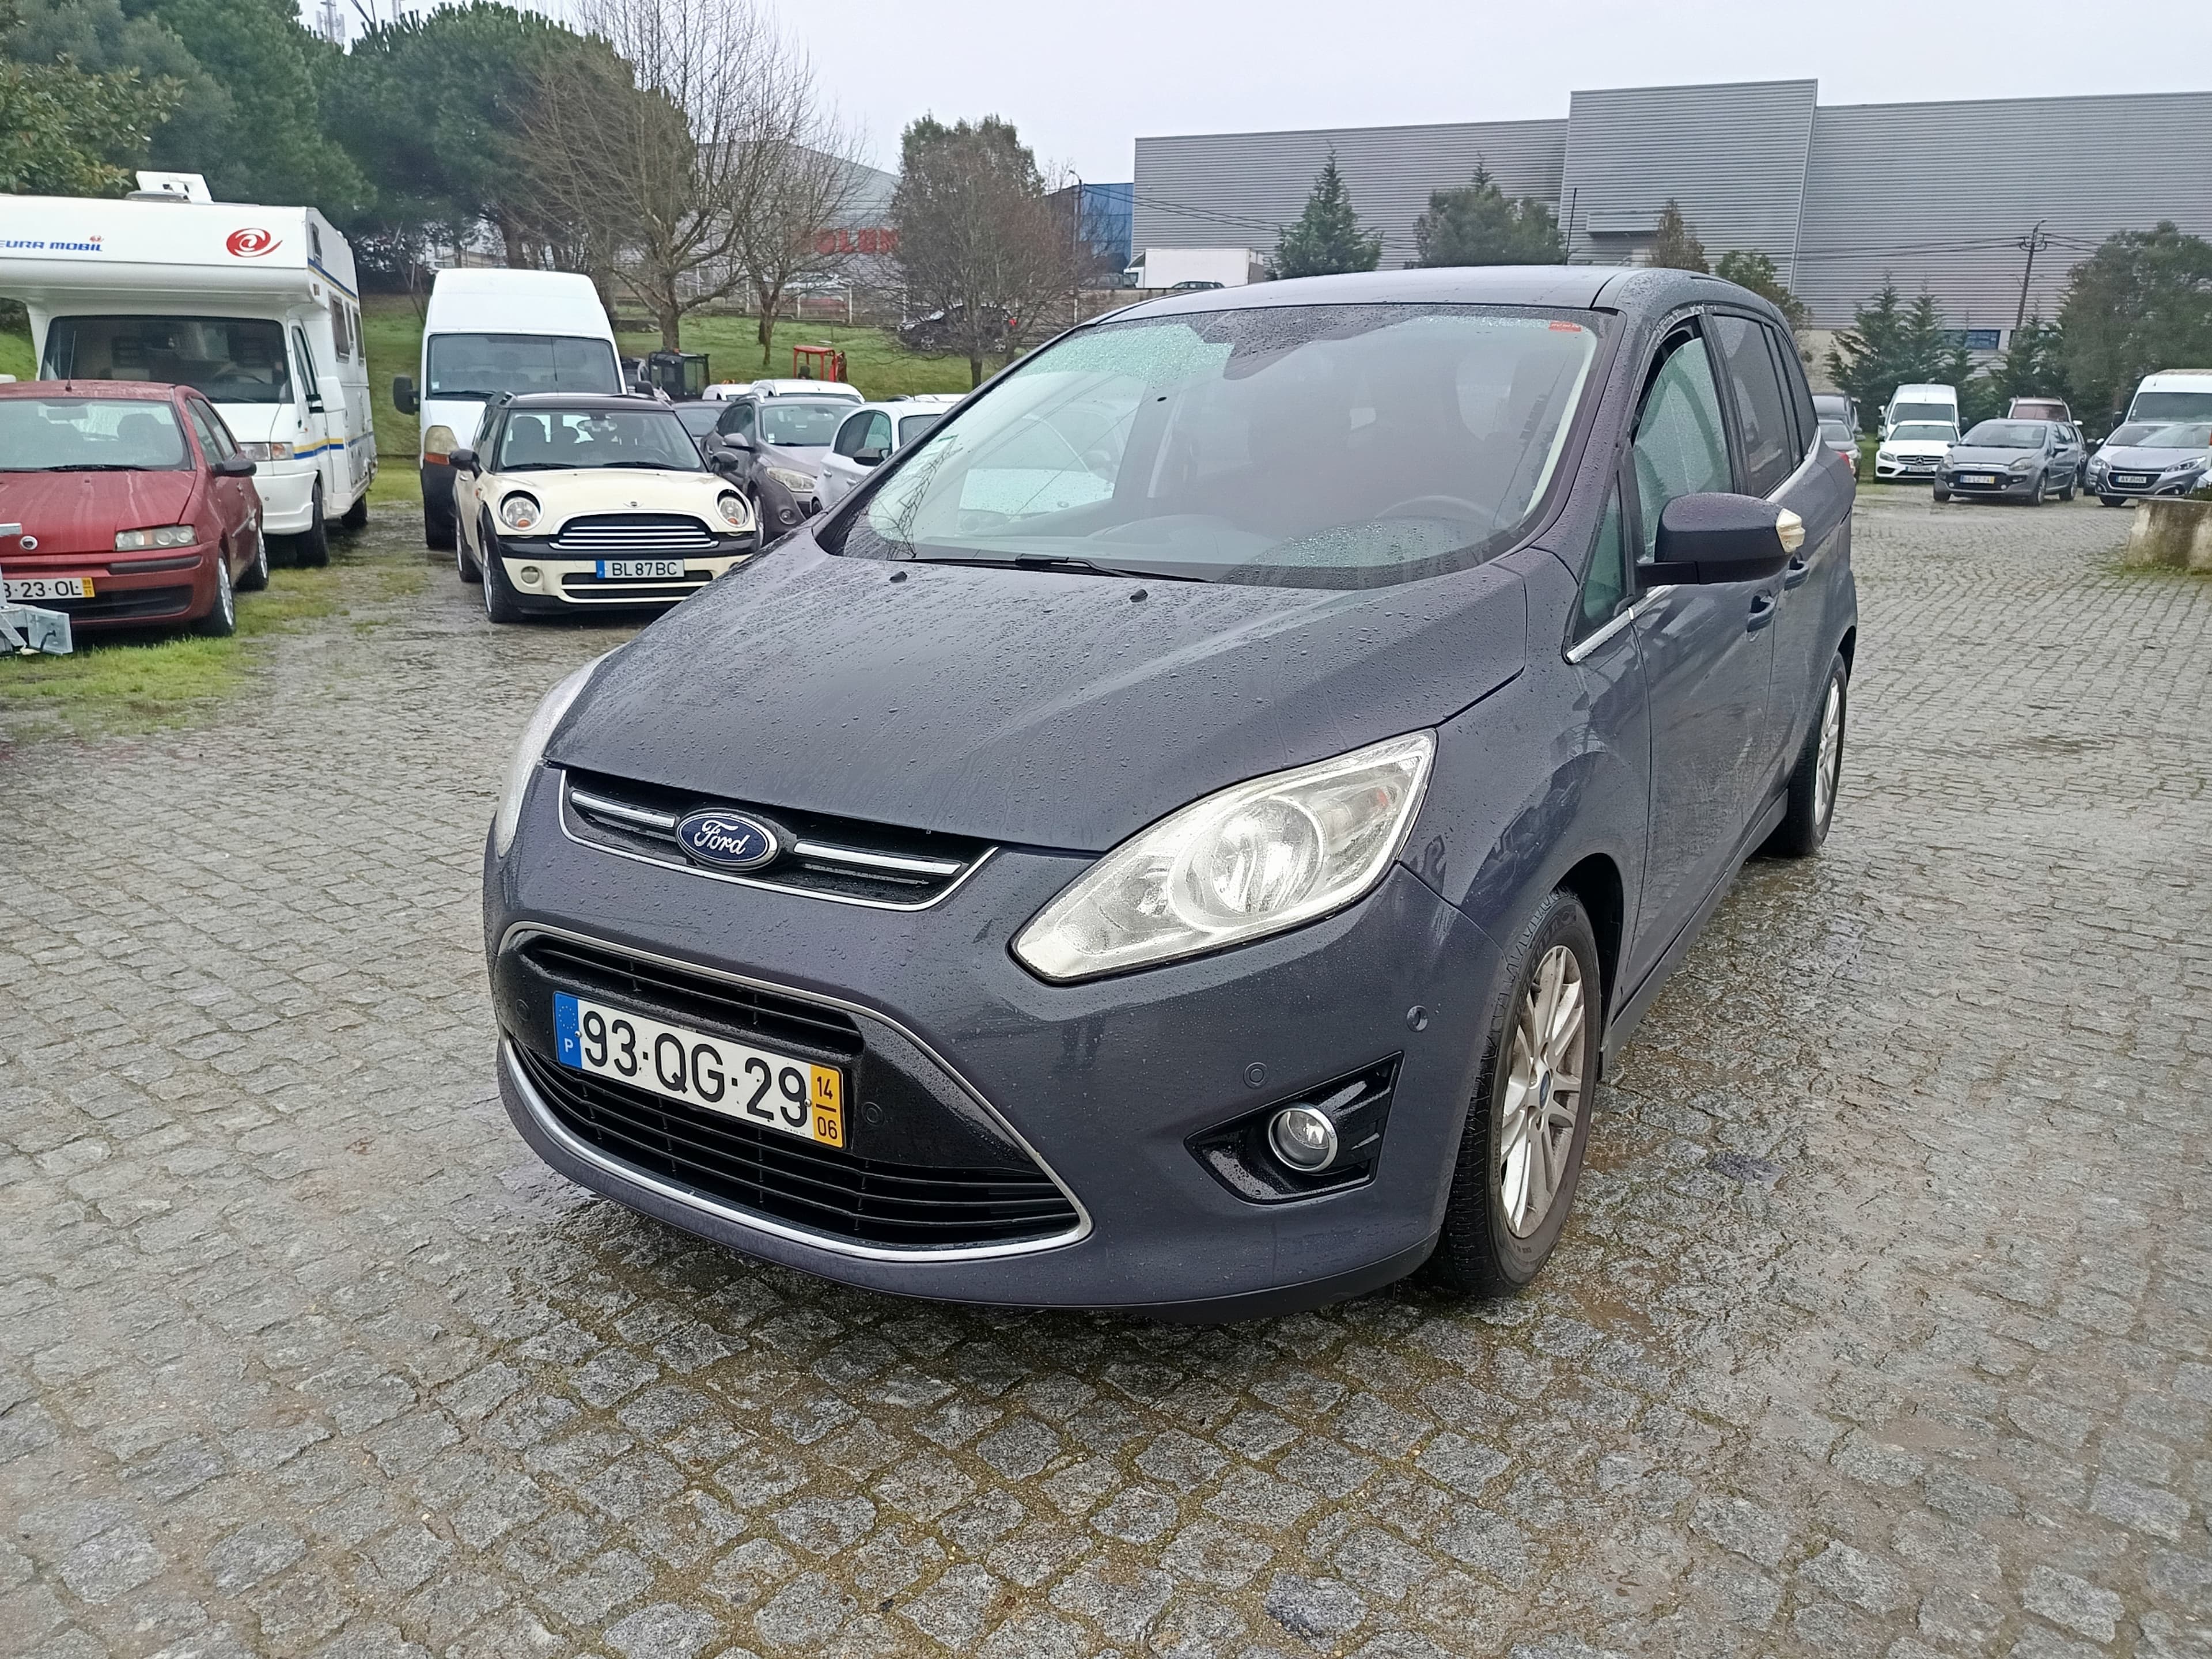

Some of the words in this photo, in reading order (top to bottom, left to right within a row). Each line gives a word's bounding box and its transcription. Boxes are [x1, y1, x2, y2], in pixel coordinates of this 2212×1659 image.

[0, 240, 45, 249] EURA
[50, 242, 103, 251] MOBIL
[694, 820, 751, 855] Ford
[564, 1037, 574, 1053] P
[817, 1076, 833, 1100] 14
[817, 1116, 837, 1139] 06
